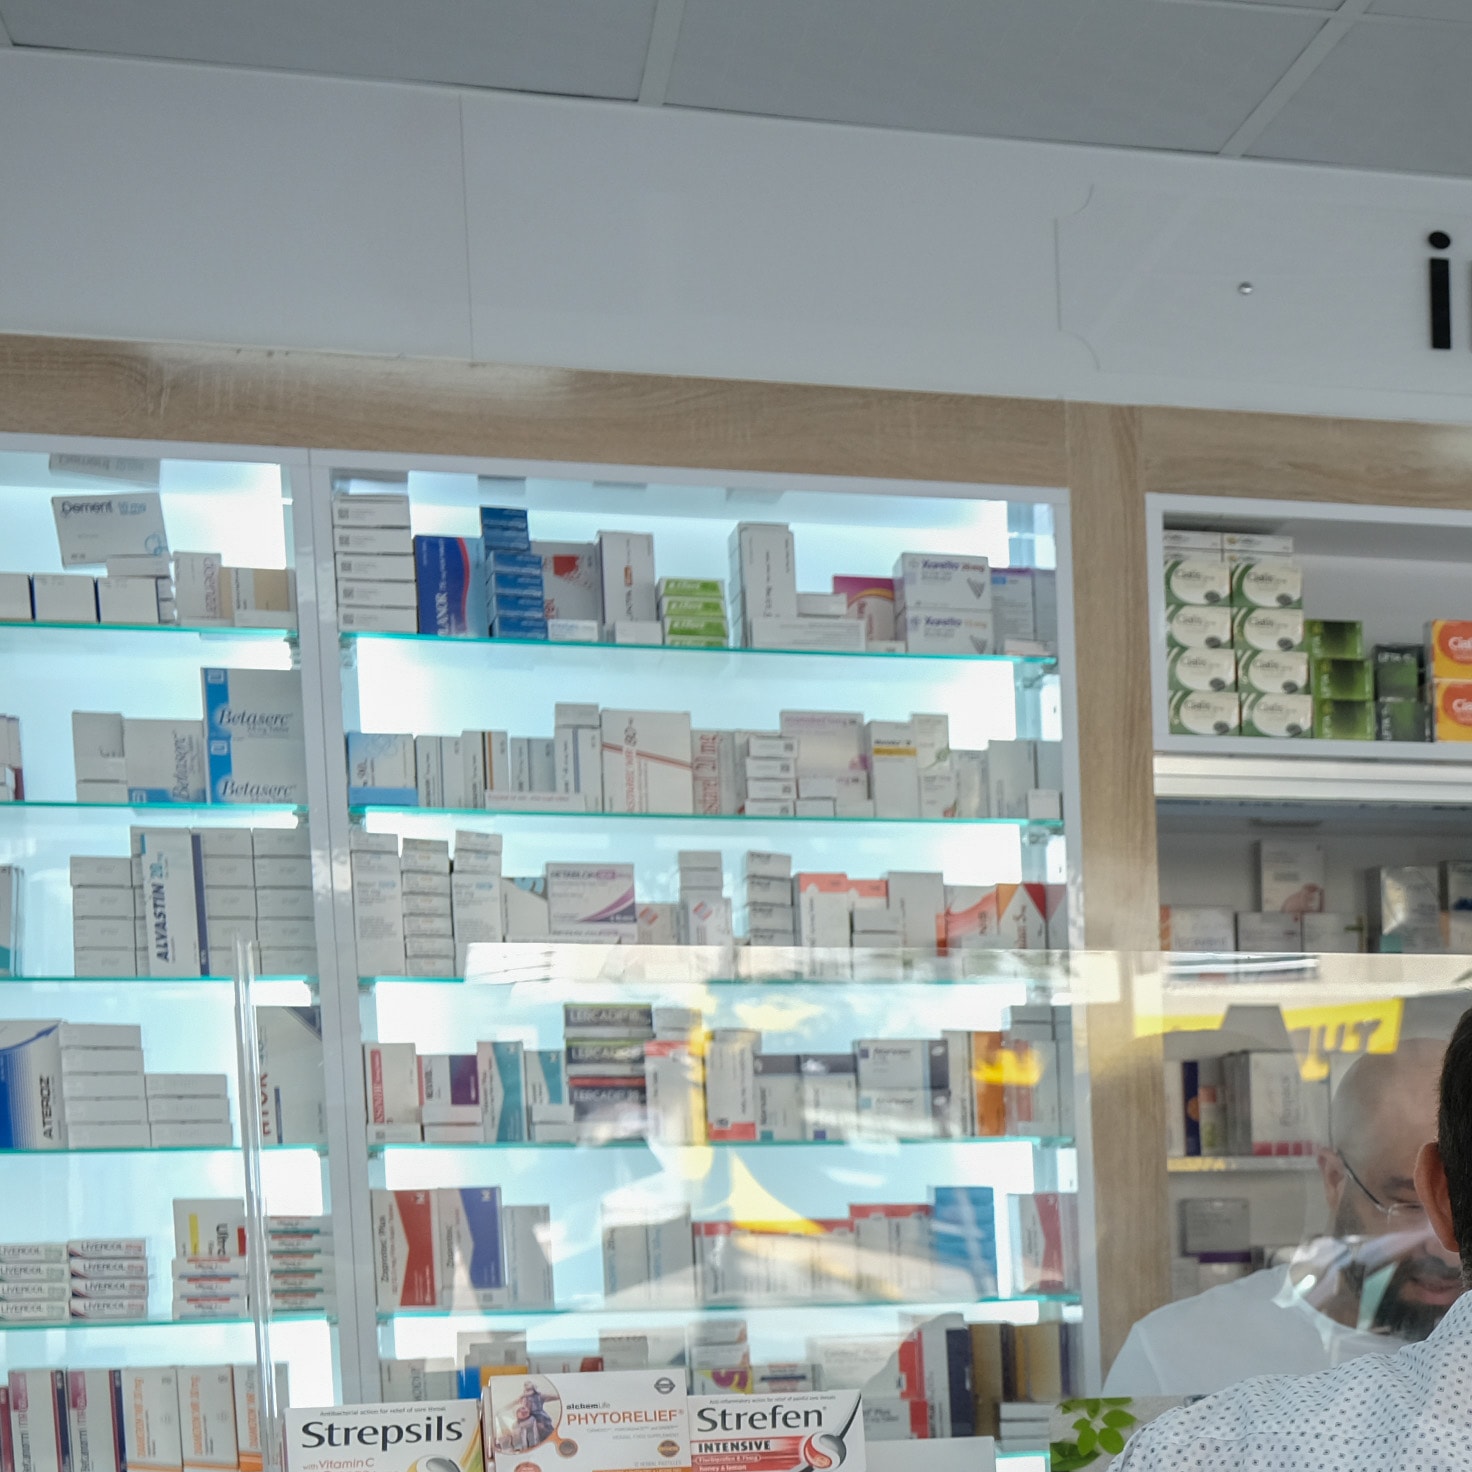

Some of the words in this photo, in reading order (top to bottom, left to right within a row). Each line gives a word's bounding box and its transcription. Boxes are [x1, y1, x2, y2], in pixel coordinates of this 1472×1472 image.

[219, 708, 290, 726] Betaserc
[222, 781, 293, 798] Betaserc
[152, 883, 169, 962] ALVASTIN
[567, 1409, 678, 1425] PHYTORELIEF
[697, 1405, 822, 1432] Strefen
[302, 1416, 463, 1451] Strepsils
[699, 1440, 770, 1453] INTENSIVE
[319, 1458, 364, 1469] Vitamin
[365, 1458, 375, 1467] C
